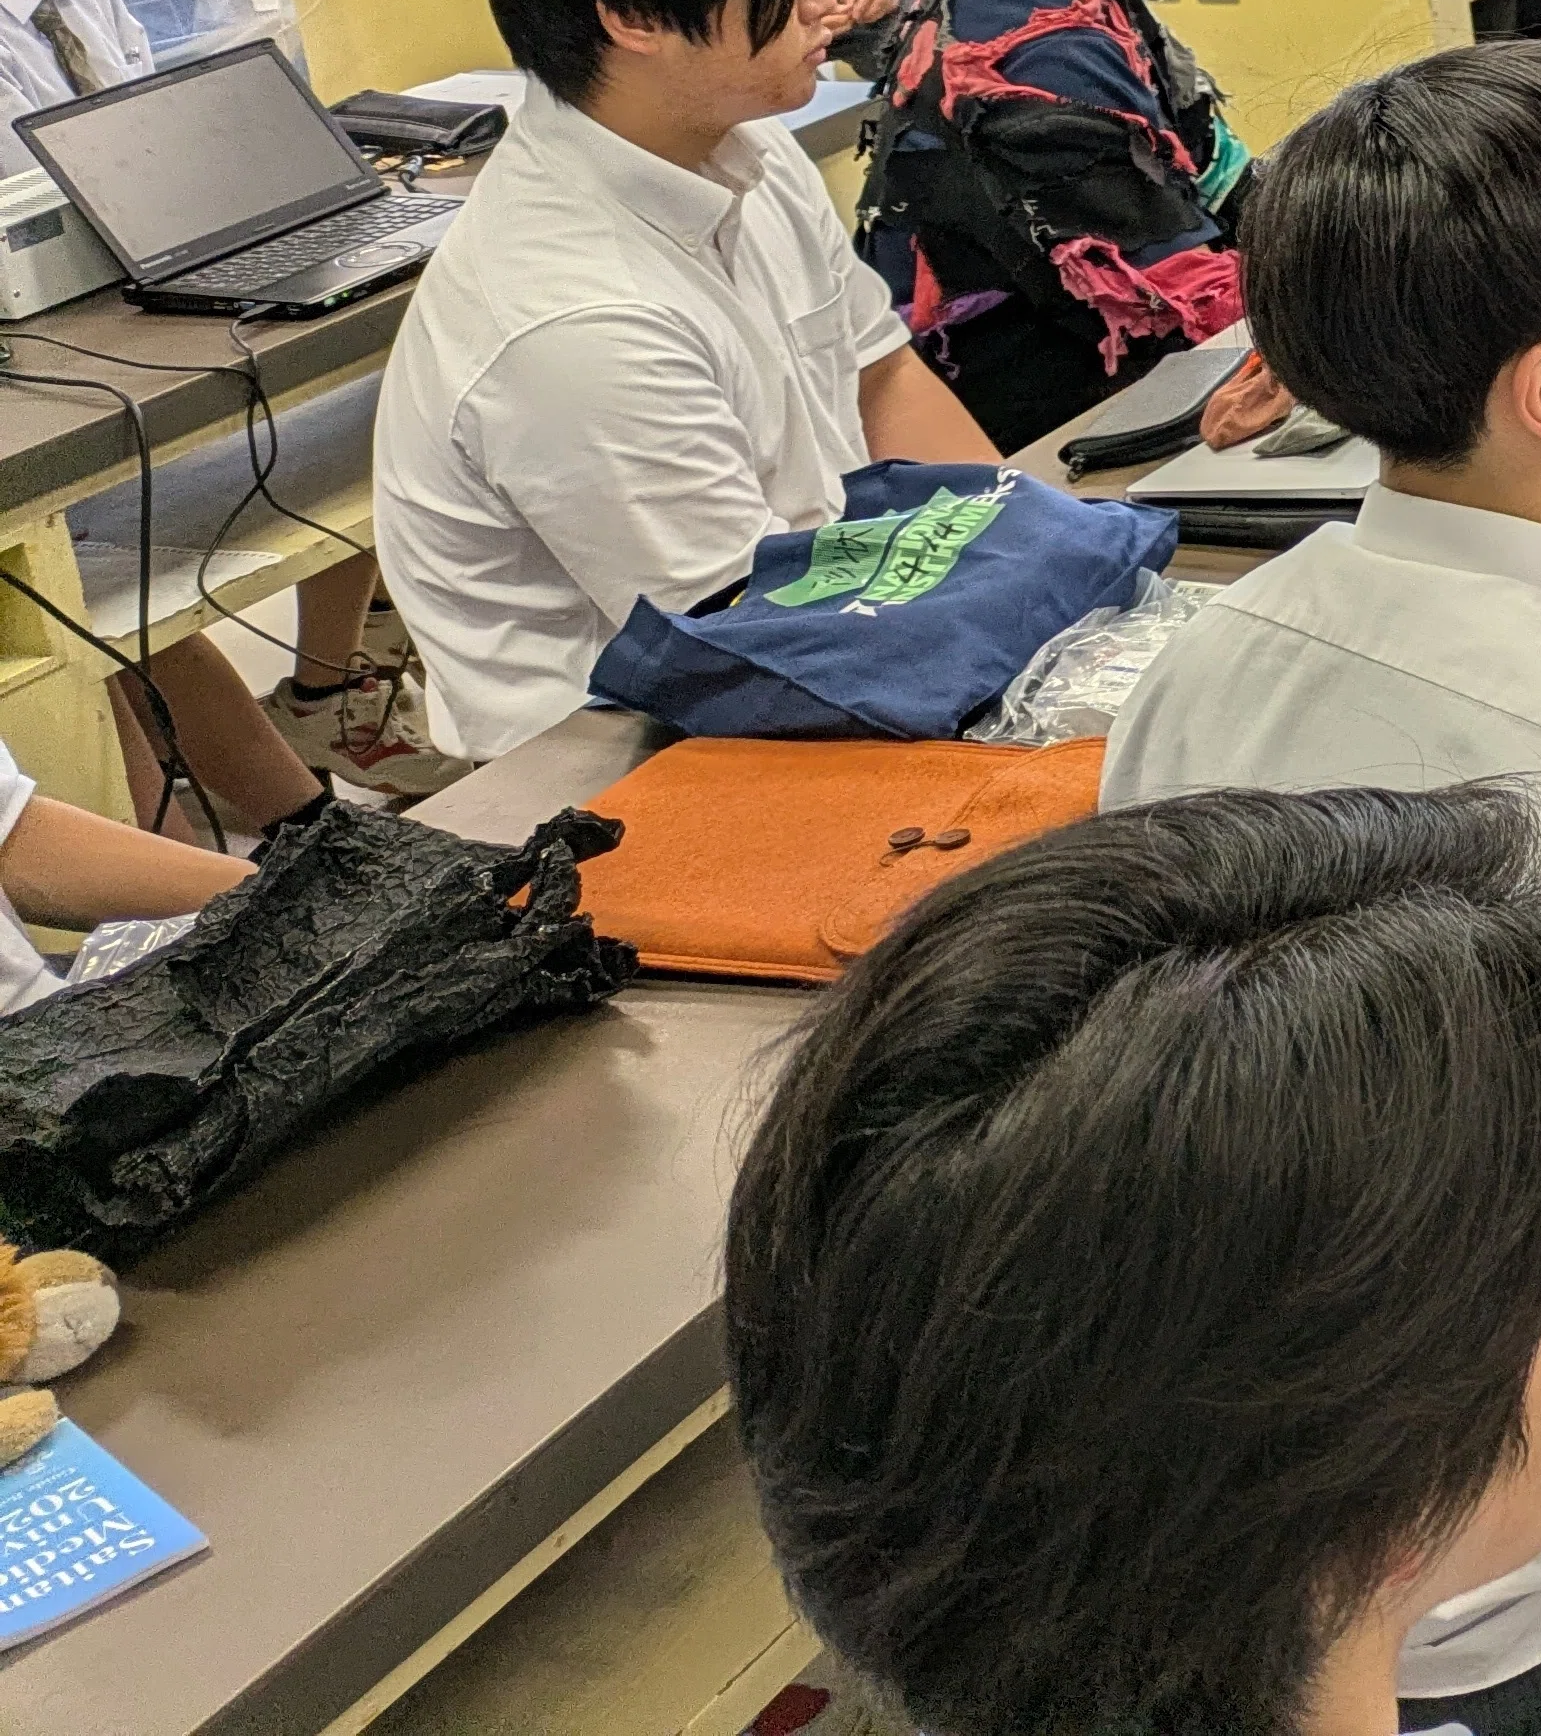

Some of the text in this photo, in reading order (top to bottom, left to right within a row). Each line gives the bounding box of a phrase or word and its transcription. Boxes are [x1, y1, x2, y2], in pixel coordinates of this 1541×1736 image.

[0, 1477, 96, 1537] 202
[2, 1497, 119, 1558] Univ
[0, 1512, 136, 1588] Medi
[0, 1530, 155, 1613] Saitam
